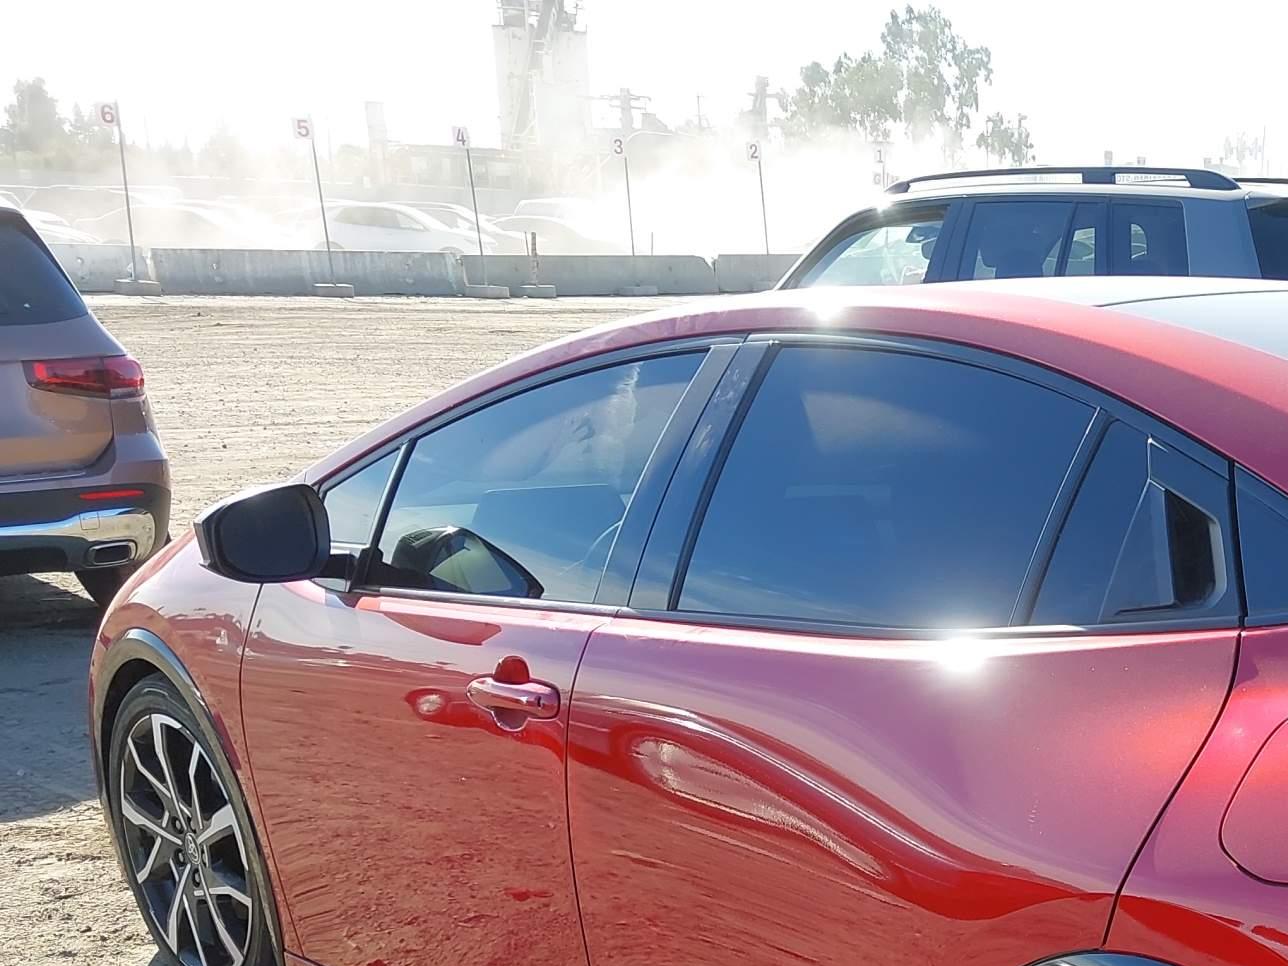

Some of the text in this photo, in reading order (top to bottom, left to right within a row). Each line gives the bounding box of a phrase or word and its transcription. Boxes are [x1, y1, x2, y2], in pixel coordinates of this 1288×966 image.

[100, 104, 114, 124] 6
[296, 119, 310, 138] 5
[456, 128, 466, 147] 4
[613, 138, 624, 155] 3
[749, 143, 759, 159] 2
